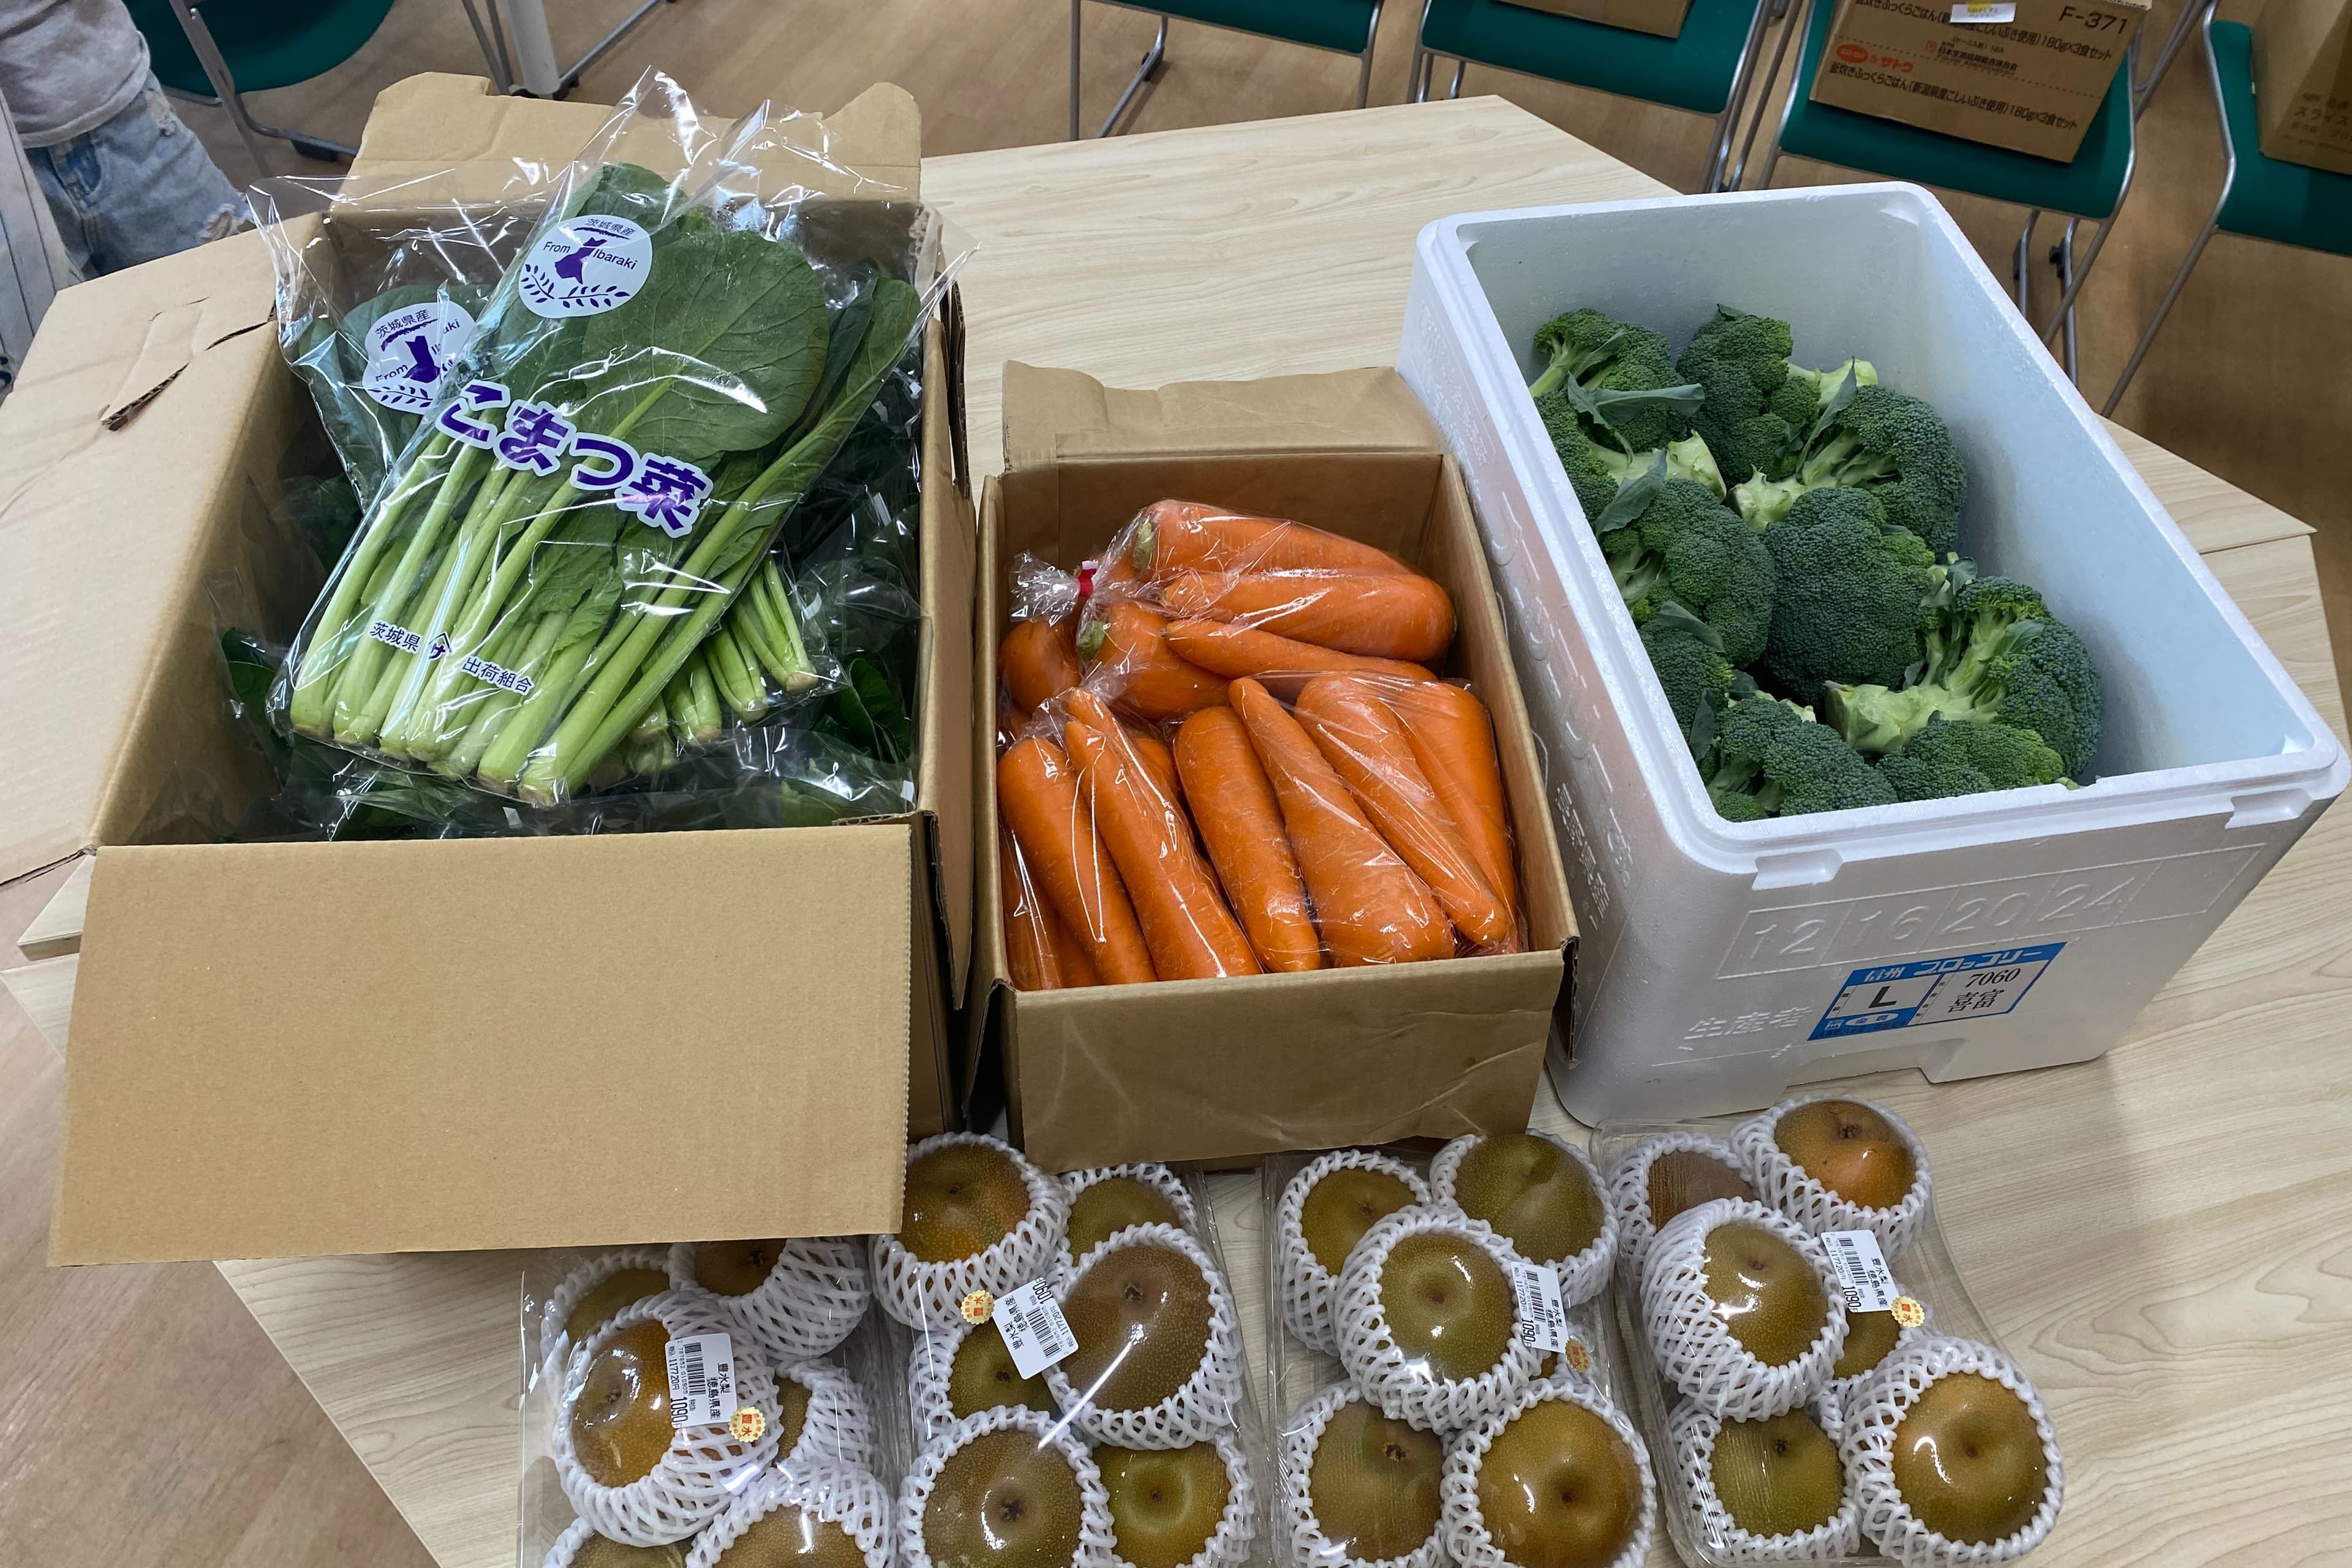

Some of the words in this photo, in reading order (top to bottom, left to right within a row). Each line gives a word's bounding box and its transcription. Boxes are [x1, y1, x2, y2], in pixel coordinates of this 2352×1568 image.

[2059, 5, 2129, 34] F-371
[1880, 56, 1914, 73] サトウ
[587, 216, 637, 238] 茨城県産
[543, 239, 571, 255] From
[592, 247, 638, 270] Ibaraki
[375, 308, 431, 339] 茨城県産
[375, 364, 409, 382] From
[437, 381, 711, 534] こまつ菜
[370, 621, 421, 653] 茨城県
[461, 657, 534, 695] 出荷組合
[1753, 919, 1826, 960] 12
[1860, 905, 1930, 942] 16
[1943, 891, 2032, 934] 20
[2049, 876, 2135, 920] 24
[1864, 966, 1903, 982] 信州
[1914, 949, 2043, 976] ブロッコリー
[1965, 968, 2021, 988] 7060
[1869, 986, 1898, 1009] L
[1948, 989, 2004, 1014] 喜富
[1684, 1006, 1814, 1040] 生産者
[1871, 1257, 1890, 1285] 豊水梨
[1866, 1270, 1888, 1308] 徳島県産
[973, 1294, 984, 1317] 豊水
[1005, 1295, 1030, 1332] 徳島県産
[1550, 1298, 1564, 1327] 豊水梨
[1003, 1321, 1024, 1350] 豊水梨
[1545, 1309, 1559, 1348] 徳島県産
[717, 1363, 731, 1394] 豊水梨
[706, 1376, 722, 1420] 徳島県産
[741, 1413, 753, 1437] 豊水
